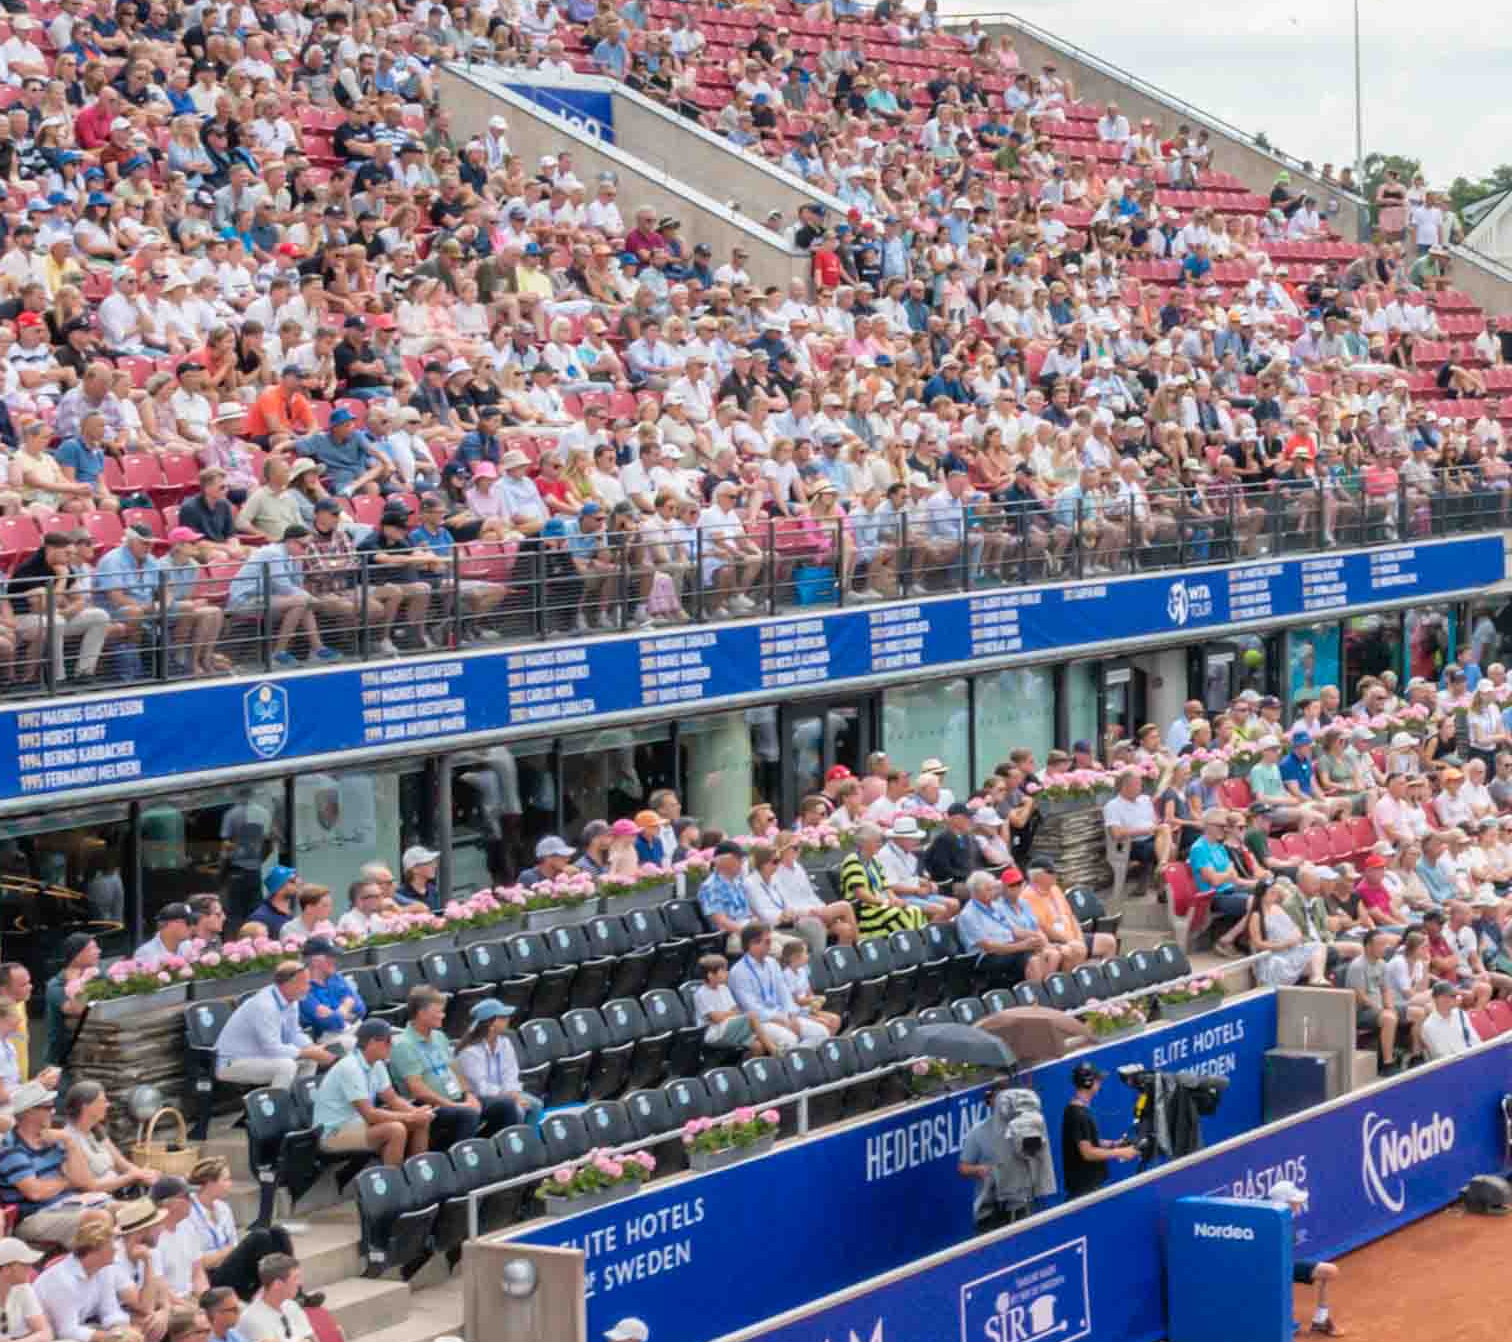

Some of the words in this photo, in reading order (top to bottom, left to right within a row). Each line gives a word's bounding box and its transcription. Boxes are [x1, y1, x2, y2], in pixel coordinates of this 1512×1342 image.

[1153, 1038, 1188, 1068] ELITE
[1193, 1019, 1244, 1053] HOTELS
[1380, 1111, 1455, 1173] Nolato
[625, 1197, 705, 1241] HOTELS
[1194, 1222, 1254, 1240] Nordea
[603, 1239, 691, 1292] SWEDEN
